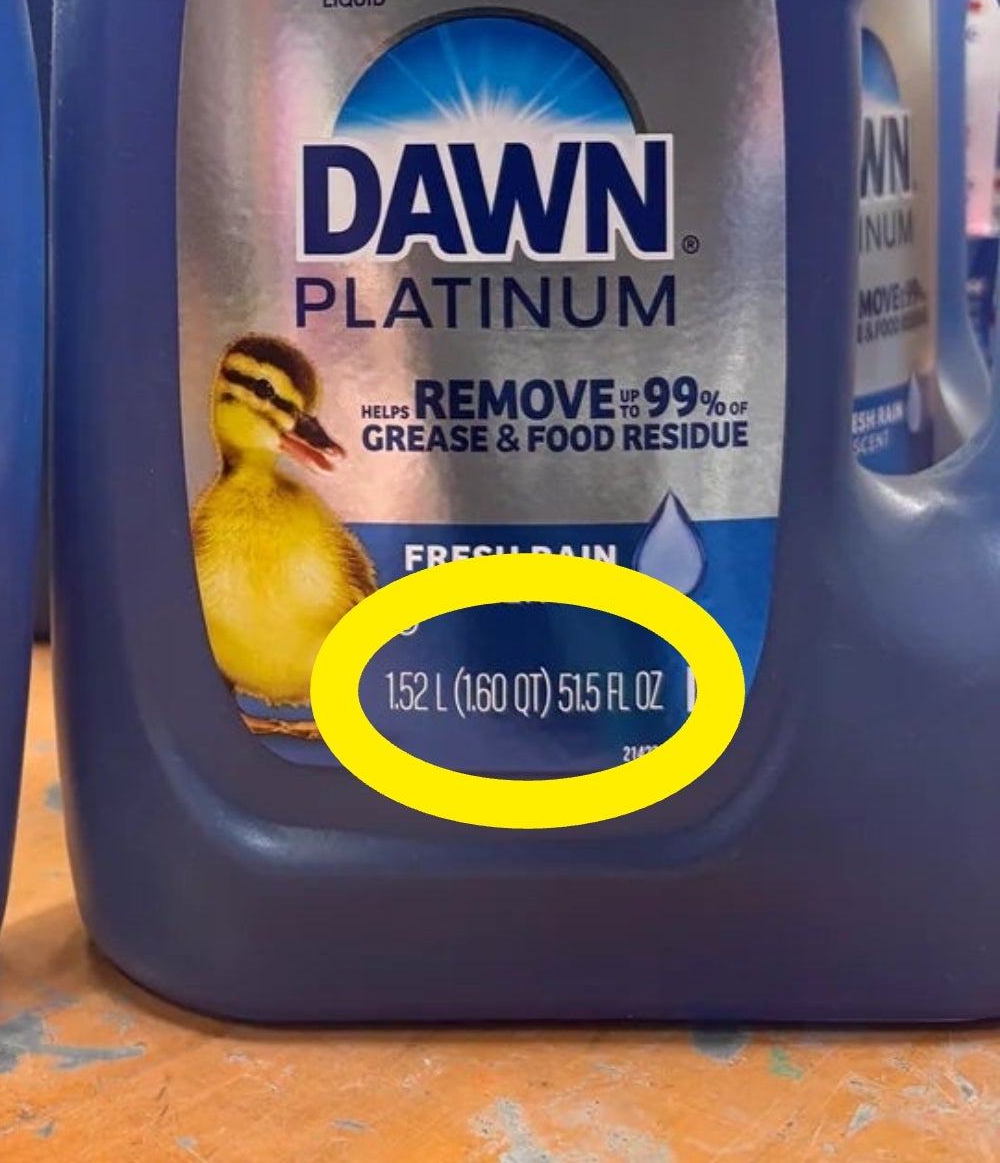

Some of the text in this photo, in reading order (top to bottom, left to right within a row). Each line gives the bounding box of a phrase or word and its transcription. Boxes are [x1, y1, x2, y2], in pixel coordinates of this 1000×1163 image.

[302, 139, 668, 256] DAWN
[296, 275, 675, 328] PLATINUM
[361, 376, 749, 420] HELPS REMOVE UP TO 99% OF
[362, 421, 749, 453] GREASE & FOOD RESIDUE
[385, 666, 664, 719] 1.52 L (1.60 QT) 51.5 FL OZ
